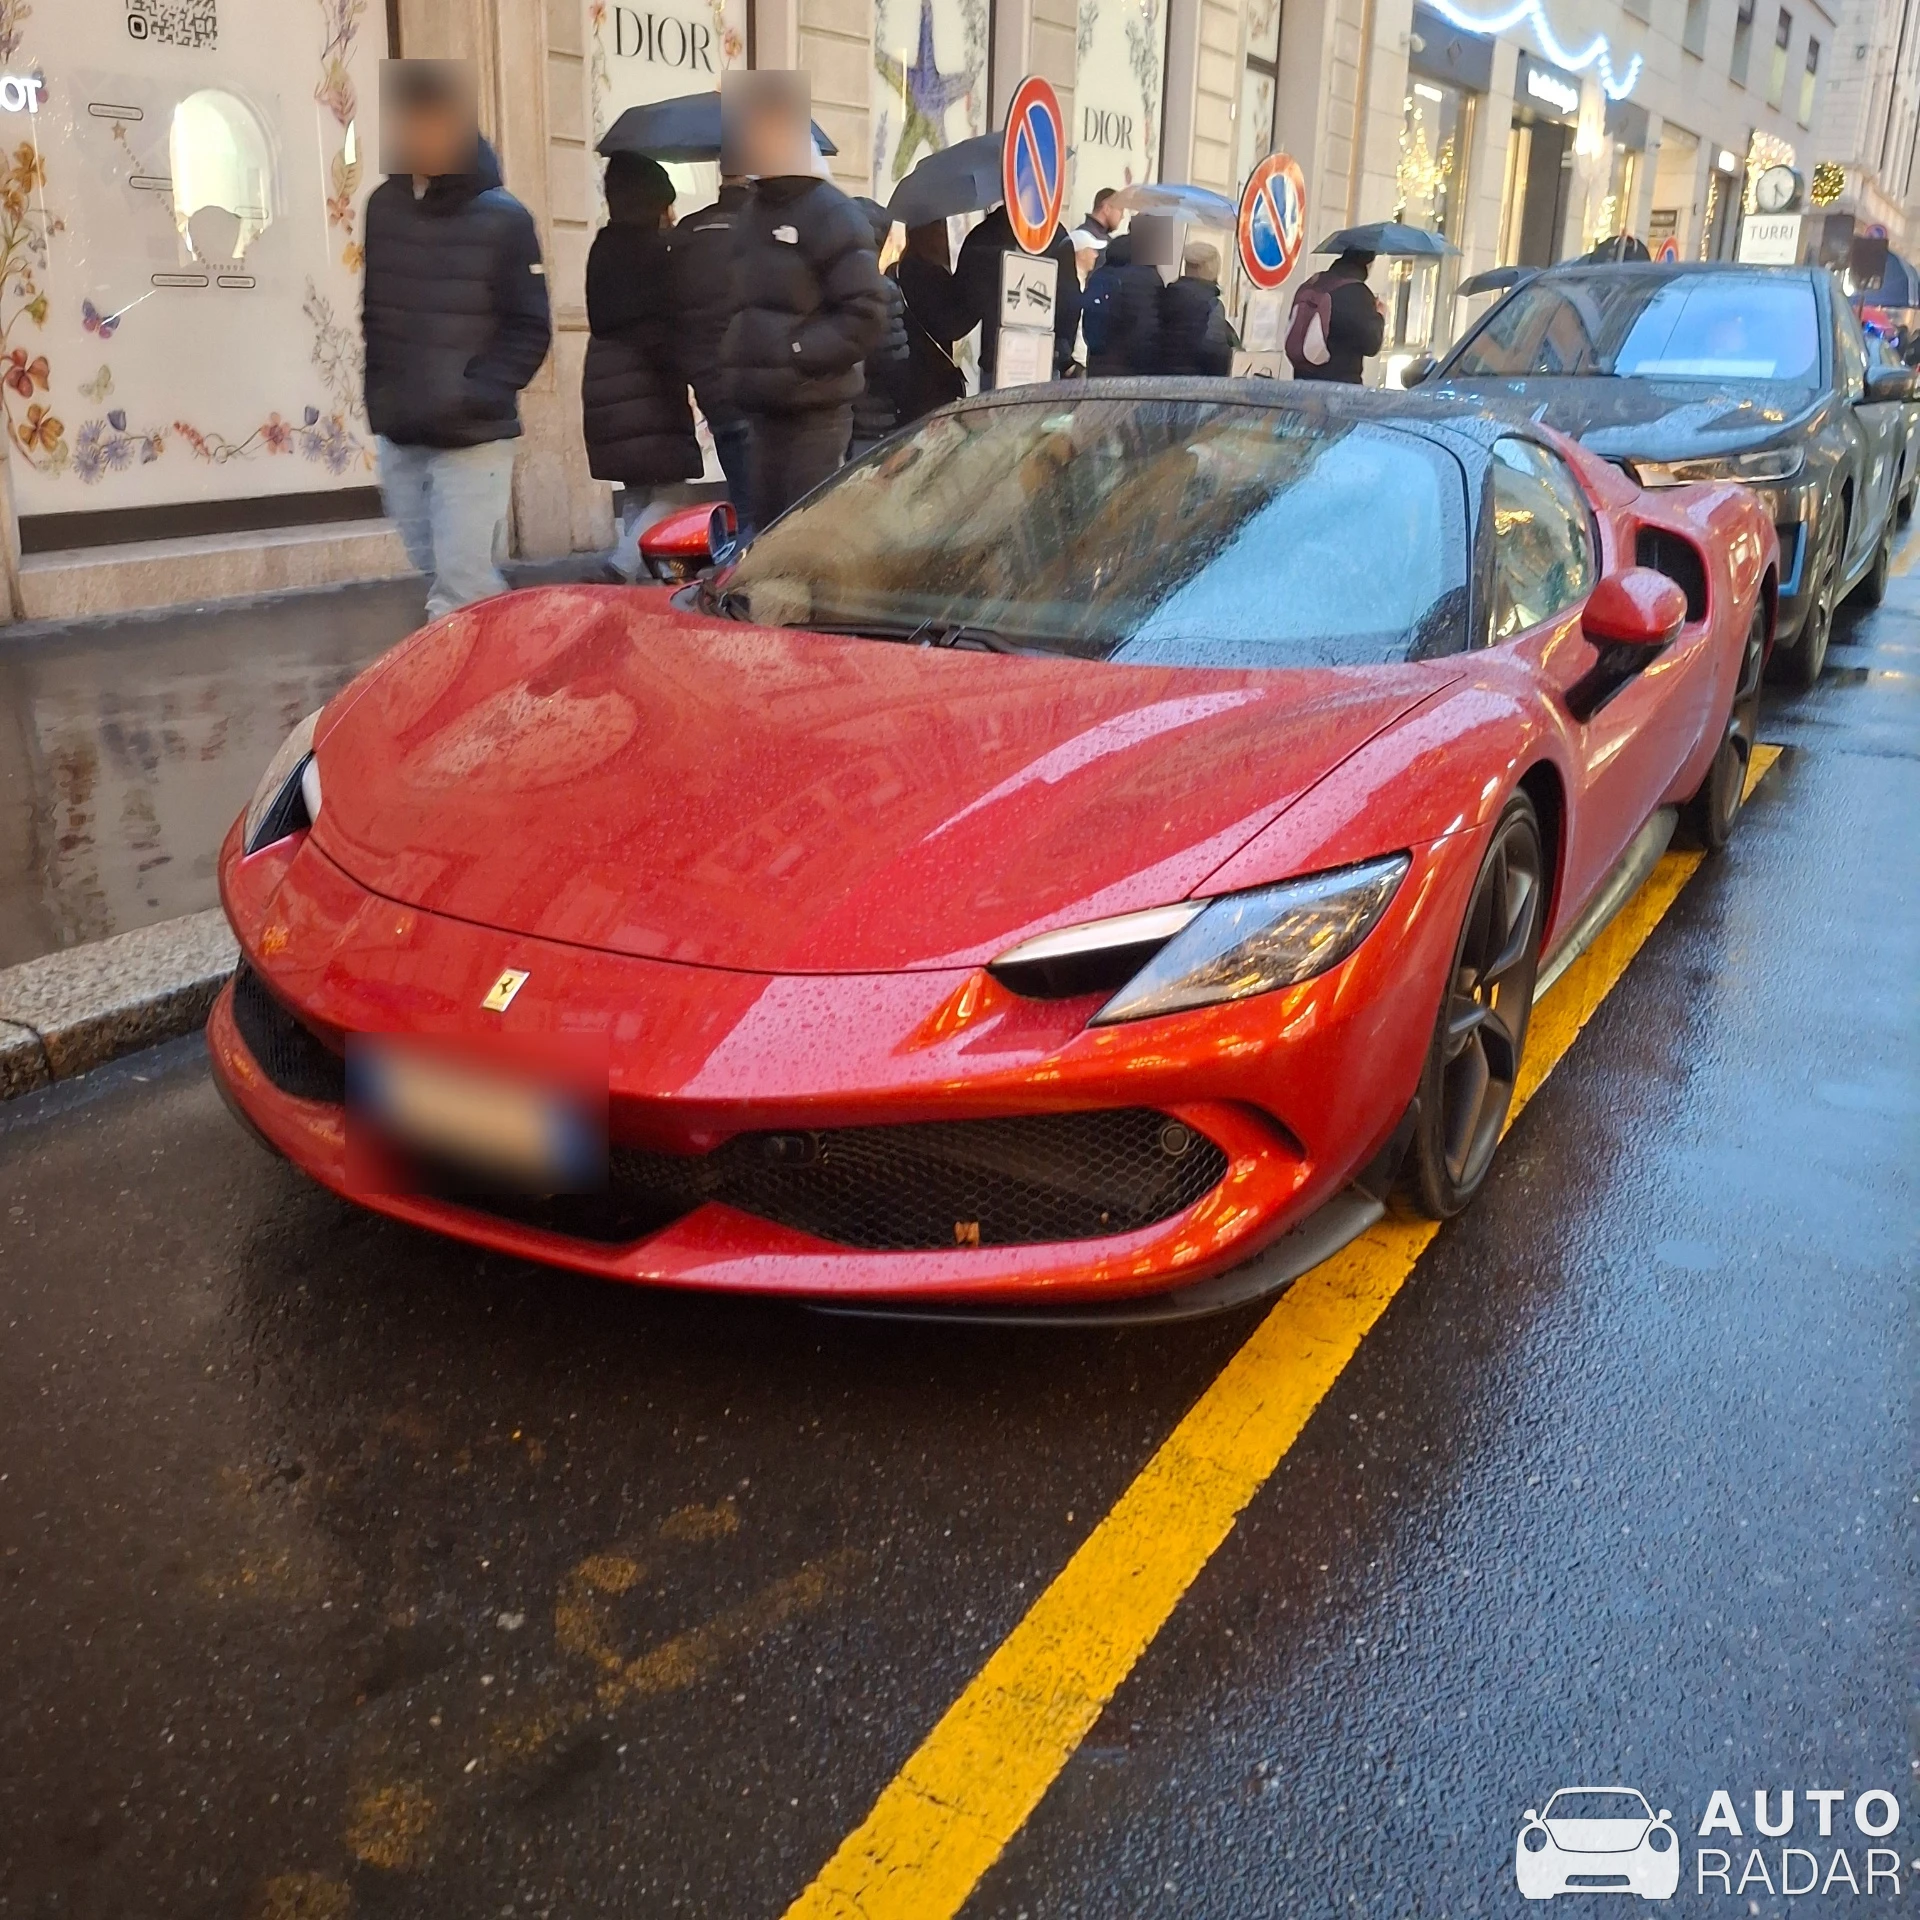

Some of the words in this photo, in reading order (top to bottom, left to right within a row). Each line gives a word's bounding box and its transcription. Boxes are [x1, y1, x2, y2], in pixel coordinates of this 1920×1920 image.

[613, 6, 715, 74] DIOR
[1083, 106, 1133, 151] DIOR
[1750, 225, 1794, 240] TURRI
